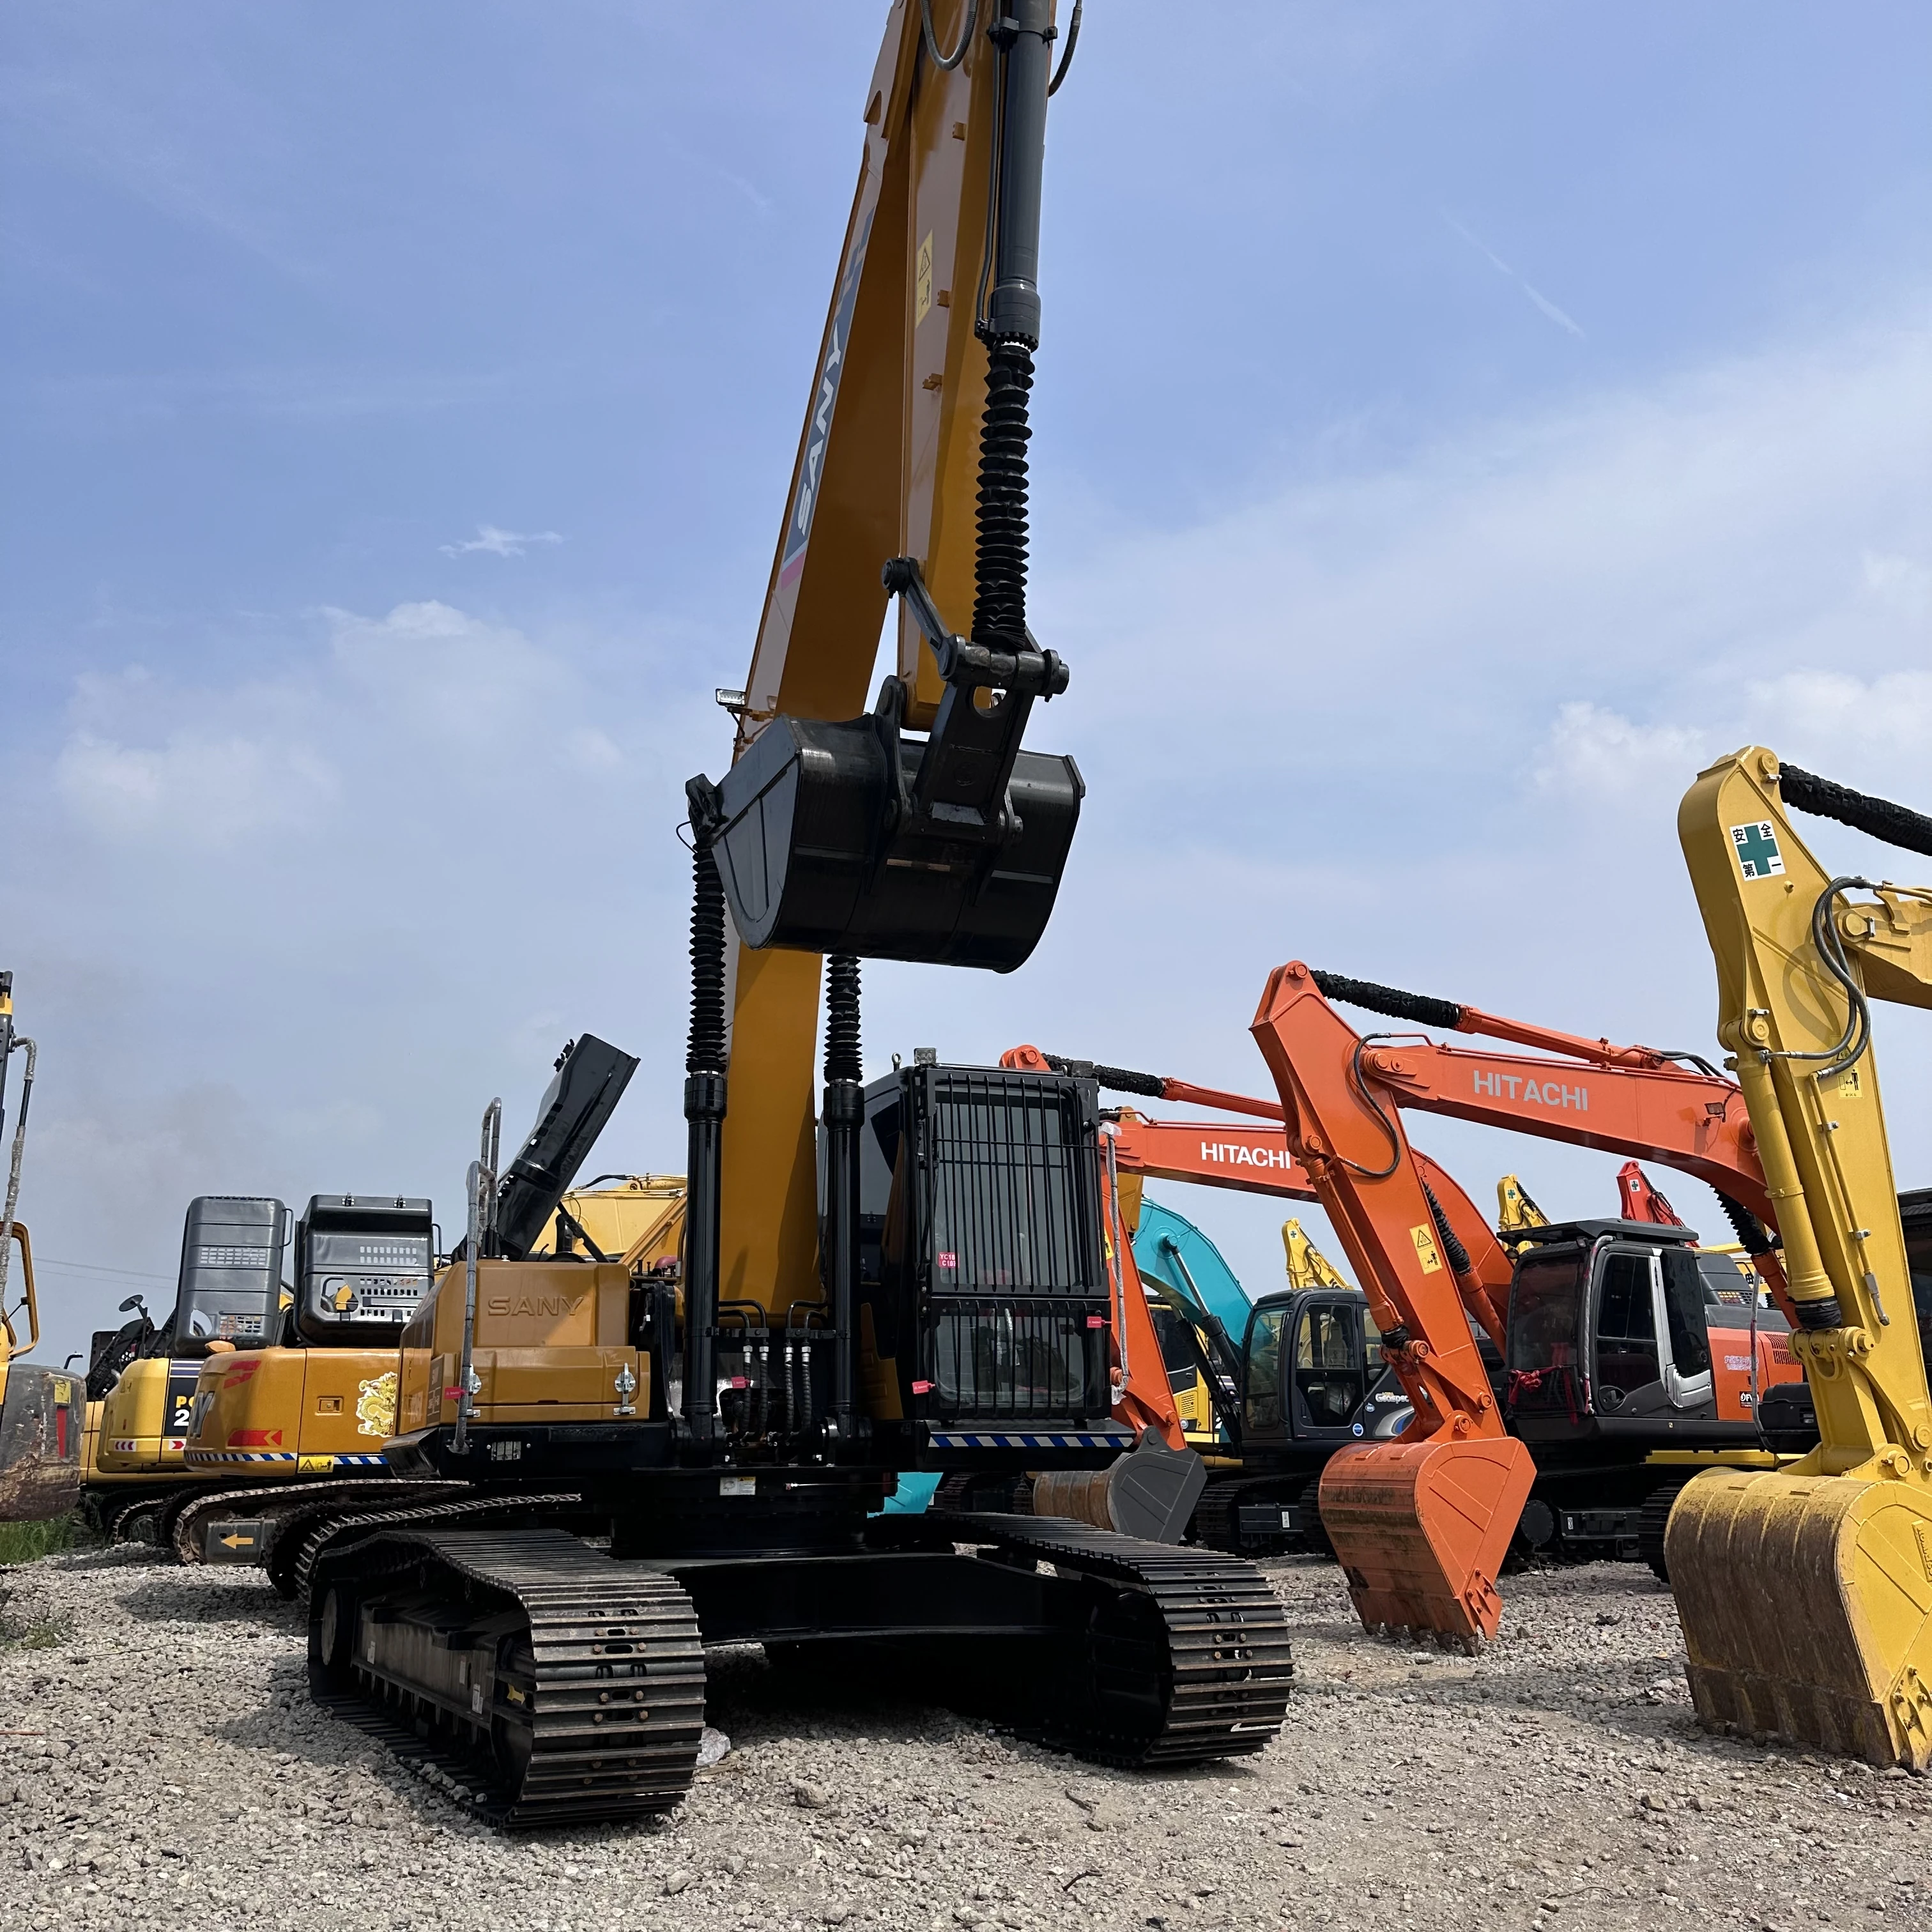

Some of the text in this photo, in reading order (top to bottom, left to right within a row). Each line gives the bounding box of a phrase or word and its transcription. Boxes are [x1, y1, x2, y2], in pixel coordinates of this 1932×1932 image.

[798, 322, 841, 536] SANY
[1474, 1070, 1588, 1111] HITACHI
[1201, 1142, 1291, 1169] HITACHI
[488, 1296, 584, 1316] SANY
